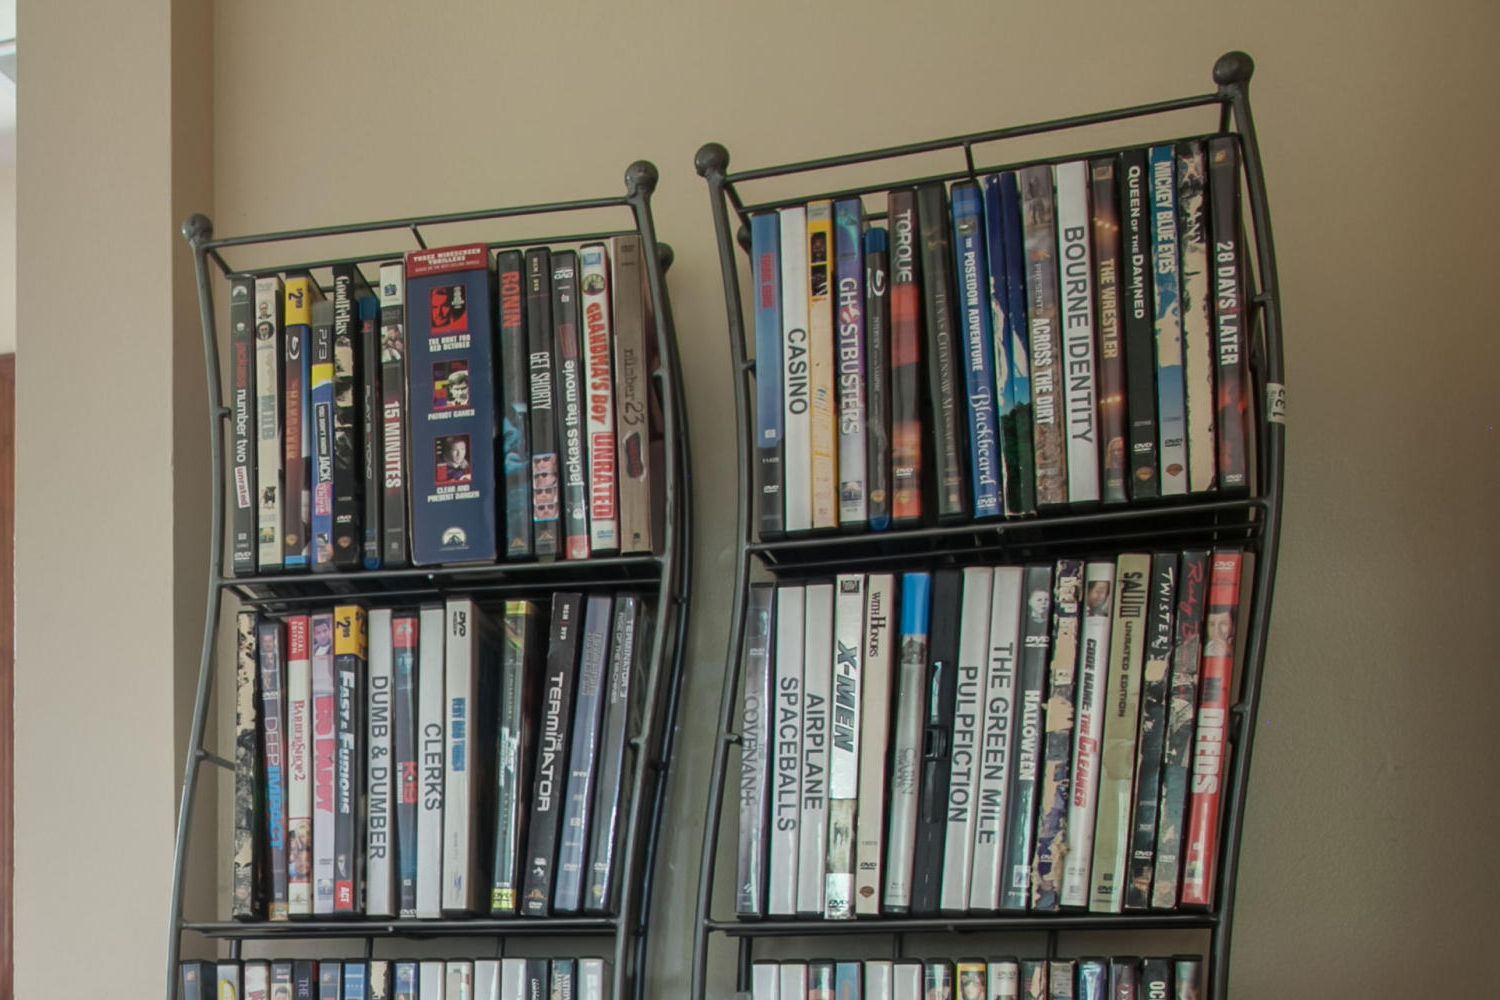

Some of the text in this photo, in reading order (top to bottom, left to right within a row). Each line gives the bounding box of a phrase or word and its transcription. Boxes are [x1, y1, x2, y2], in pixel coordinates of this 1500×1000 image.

[895, 209, 912, 281] TORQUE
[1154, 162, 1175, 274] MICKEY BLUE EYES
[502, 271, 520, 328] RONIN
[1064, 226, 1092, 443] BOURNE IDENTITY
[1100, 258, 1117, 358] THE WRESTLER
[1216, 241, 1238, 365] 28 DAYS LATER
[531, 352, 550, 410] GET SHORTY
[586, 302, 608, 426] GRANDMA'S BOY
[787, 328, 807, 414] CASINO
[840, 278, 859, 435] GHOSTBUSTERS
[1032, 318, 1054, 424] ACROSS THE DIRT
[384, 400, 401, 489] 15 MINUTES
[592, 433, 614, 520] UNRATED
[970, 386, 995, 484] Blackbeard
[538, 672, 564, 811] TERMINATOR
[834, 641, 857, 752] X-MEN
[977, 642, 1012, 844] THE GREEN MILE
[1019, 690, 1039, 780] HALLOWEEN
[264, 717, 282, 849] DEEP IMPACT
[316, 696, 334, 812] BIG DADDY
[369, 676, 388, 859] DUMB & DUMBER
[425, 723, 442, 811] CLERKS
[777, 677, 798, 831] SPACEBALLS
[804, 693, 824, 809] AIRPLANE
[1194, 708, 1224, 795] DEEDS
[339, 886, 349, 903] ACT
[298, 978, 308, 998] THE
